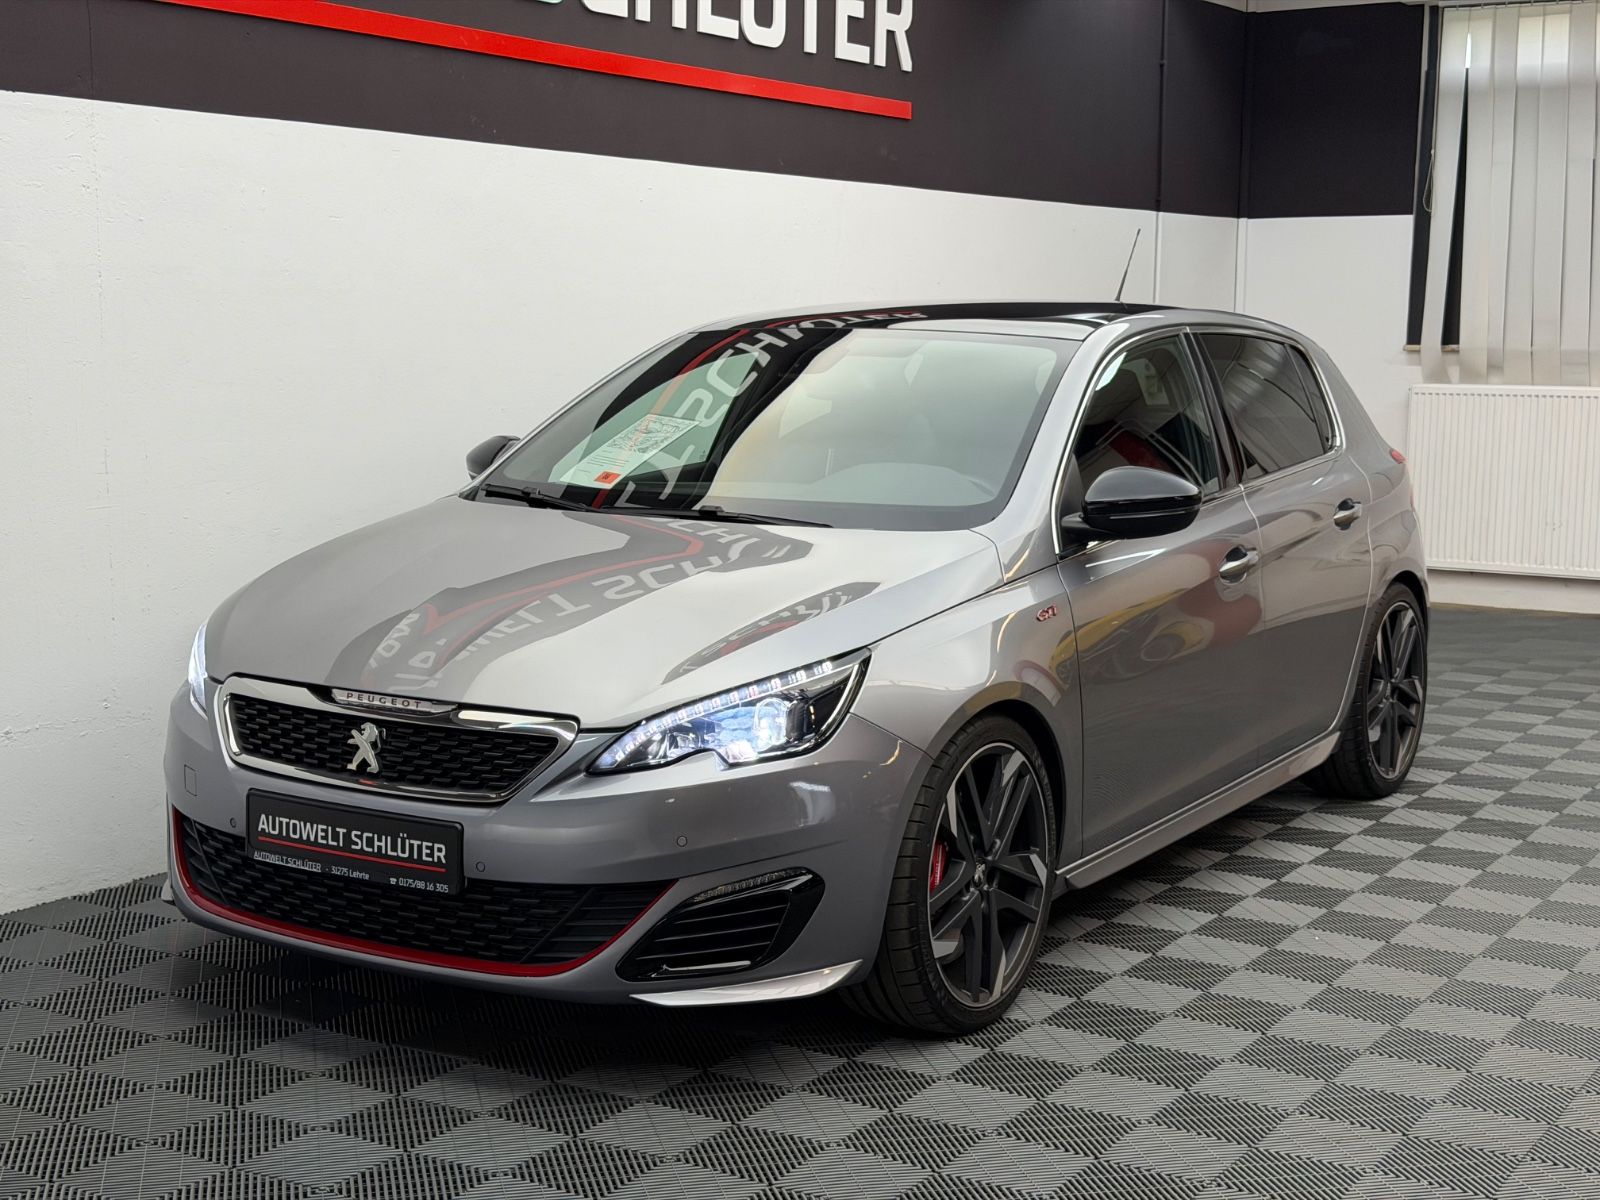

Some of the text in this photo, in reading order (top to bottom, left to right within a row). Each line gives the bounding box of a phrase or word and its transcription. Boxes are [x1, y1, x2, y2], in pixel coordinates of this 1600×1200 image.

[346, 692, 422, 709] PEUGEOT
[257, 813, 447, 864] AUTOWELT SCHLÜTER
[253, 850, 287, 867] AUTOWELT
[287, 857, 322, 873] SCHLÜTER
[330, 865, 349, 877] 31275
[349, 869, 370, 880] Lehrte
[435, 883, 449, 893] 305
